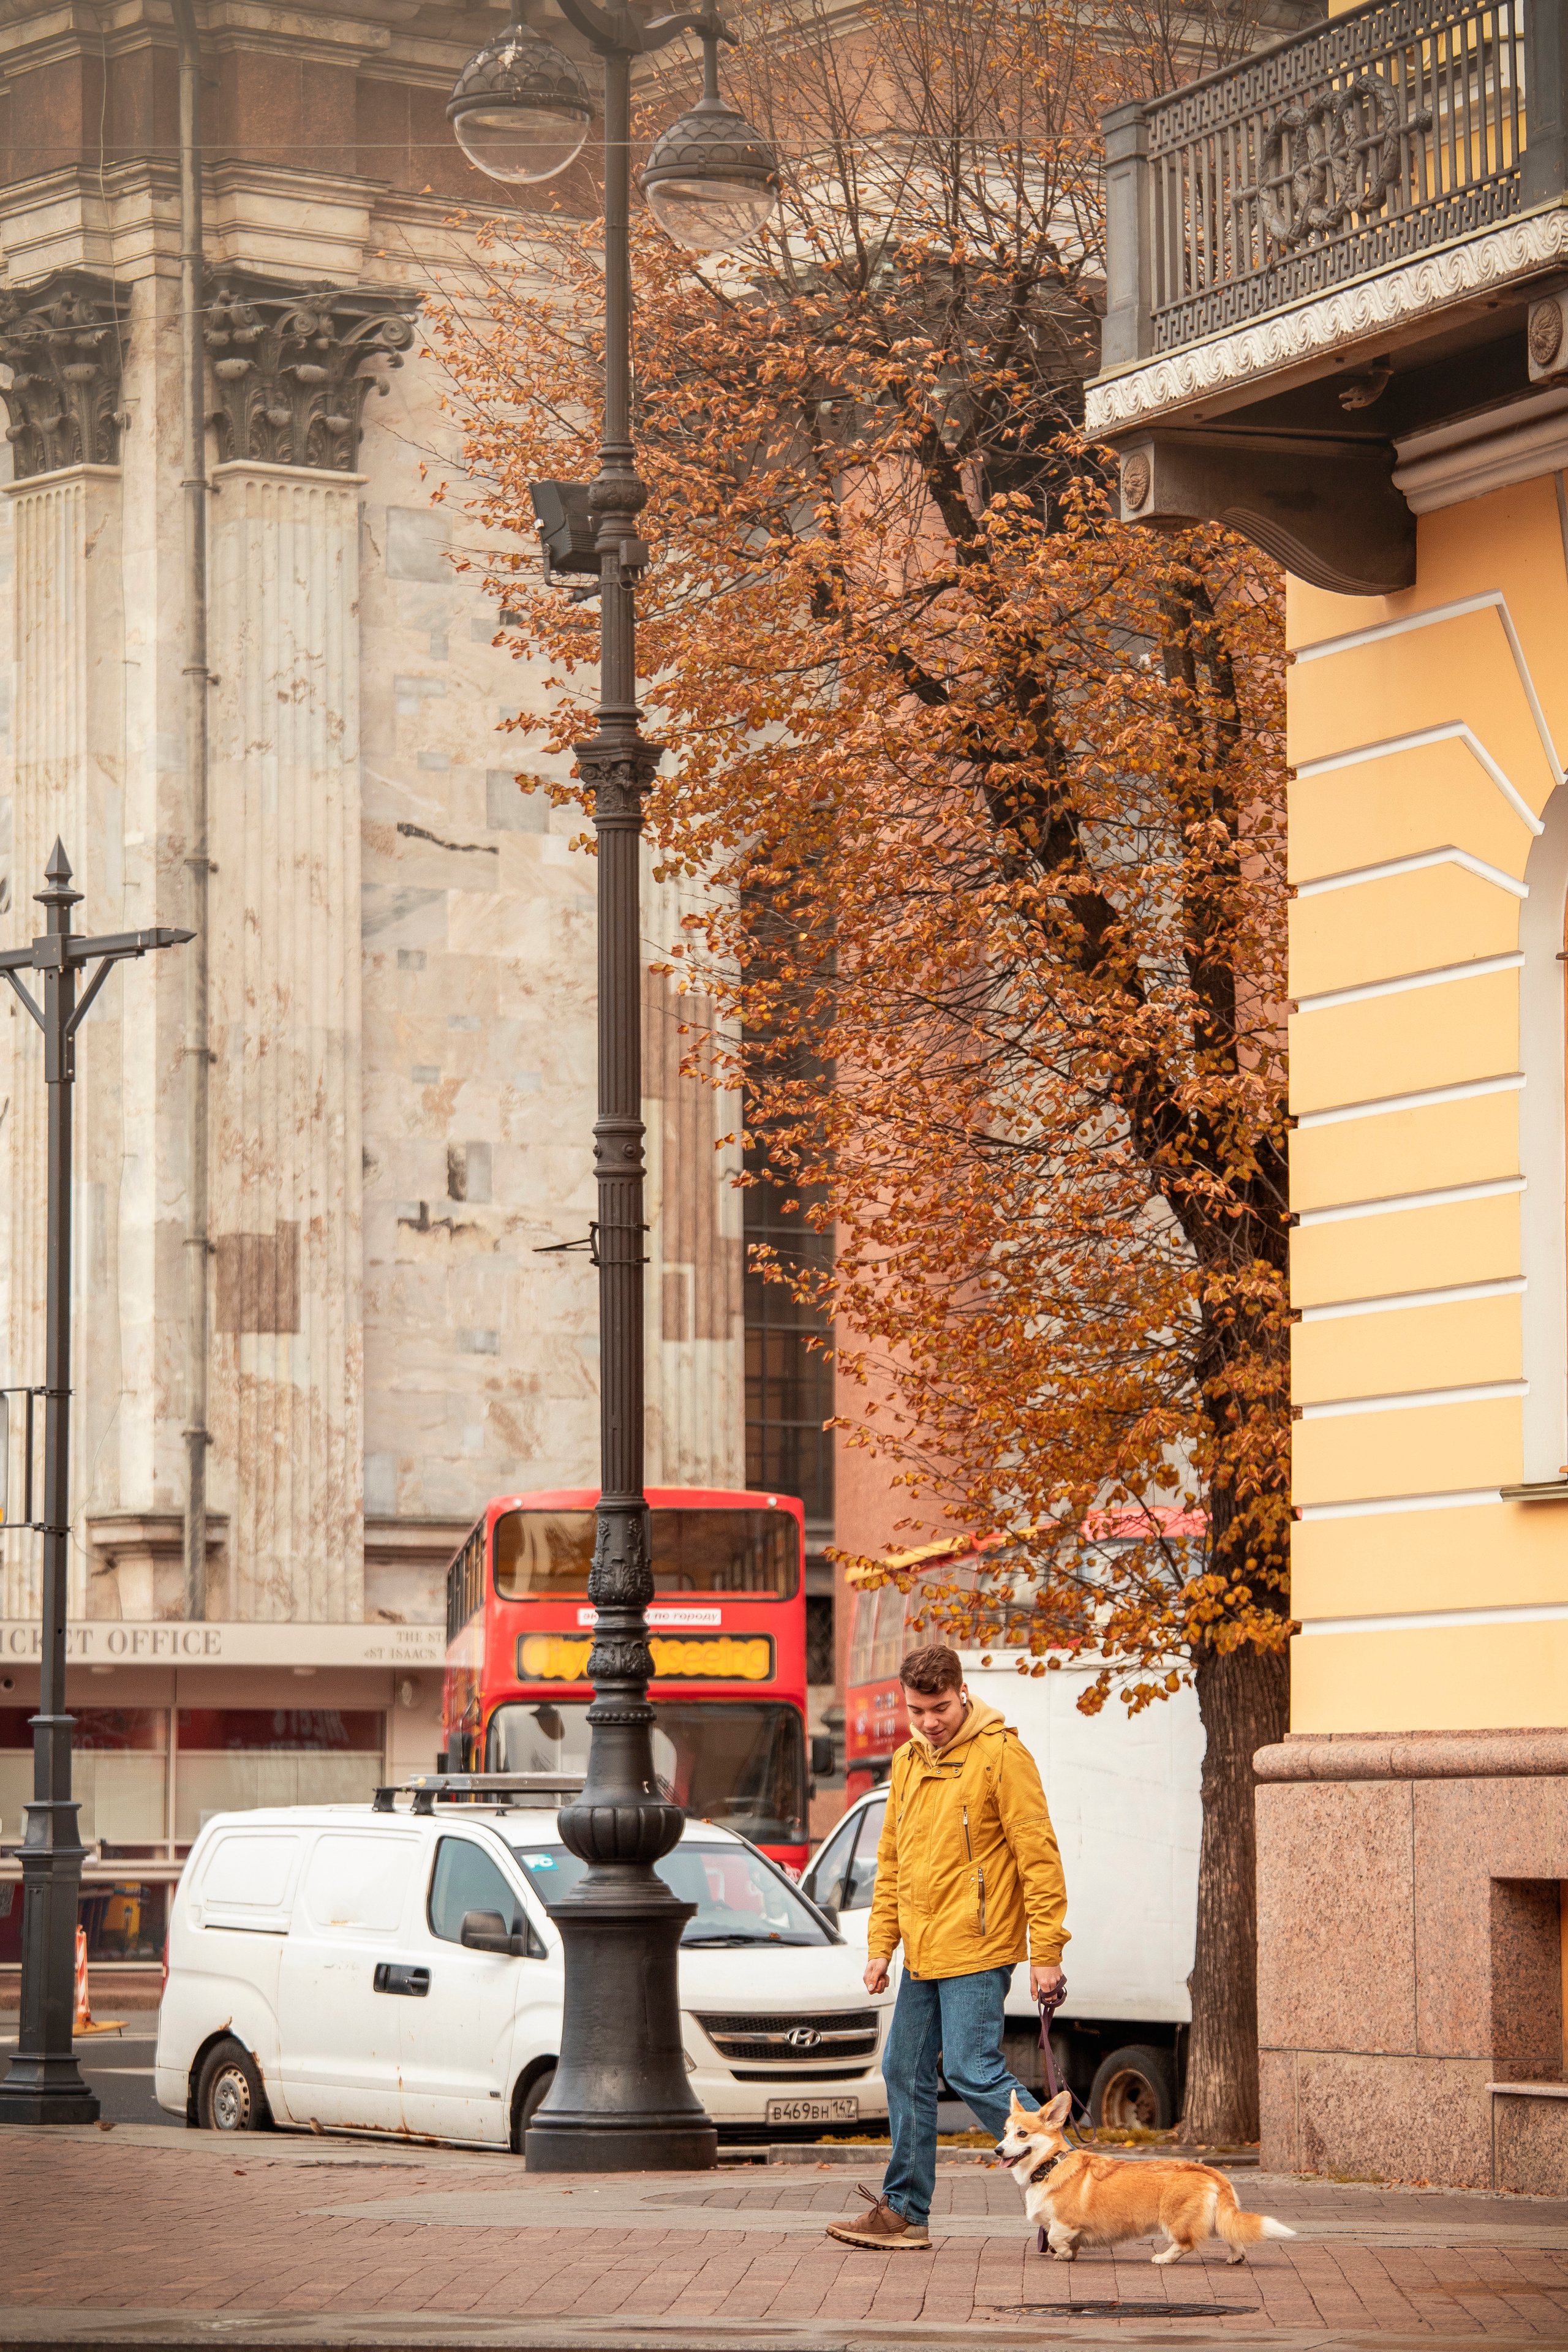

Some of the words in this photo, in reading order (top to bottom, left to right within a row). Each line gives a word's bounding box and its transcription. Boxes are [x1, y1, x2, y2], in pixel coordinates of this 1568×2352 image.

[673, 1613, 718, 1622] городу
[107, 1628, 222, 1655] OFFICE
[397, 1631, 423, 1643] THE
[524, 1638, 588, 1679] City
[832, 2100, 853, 2113] 147
